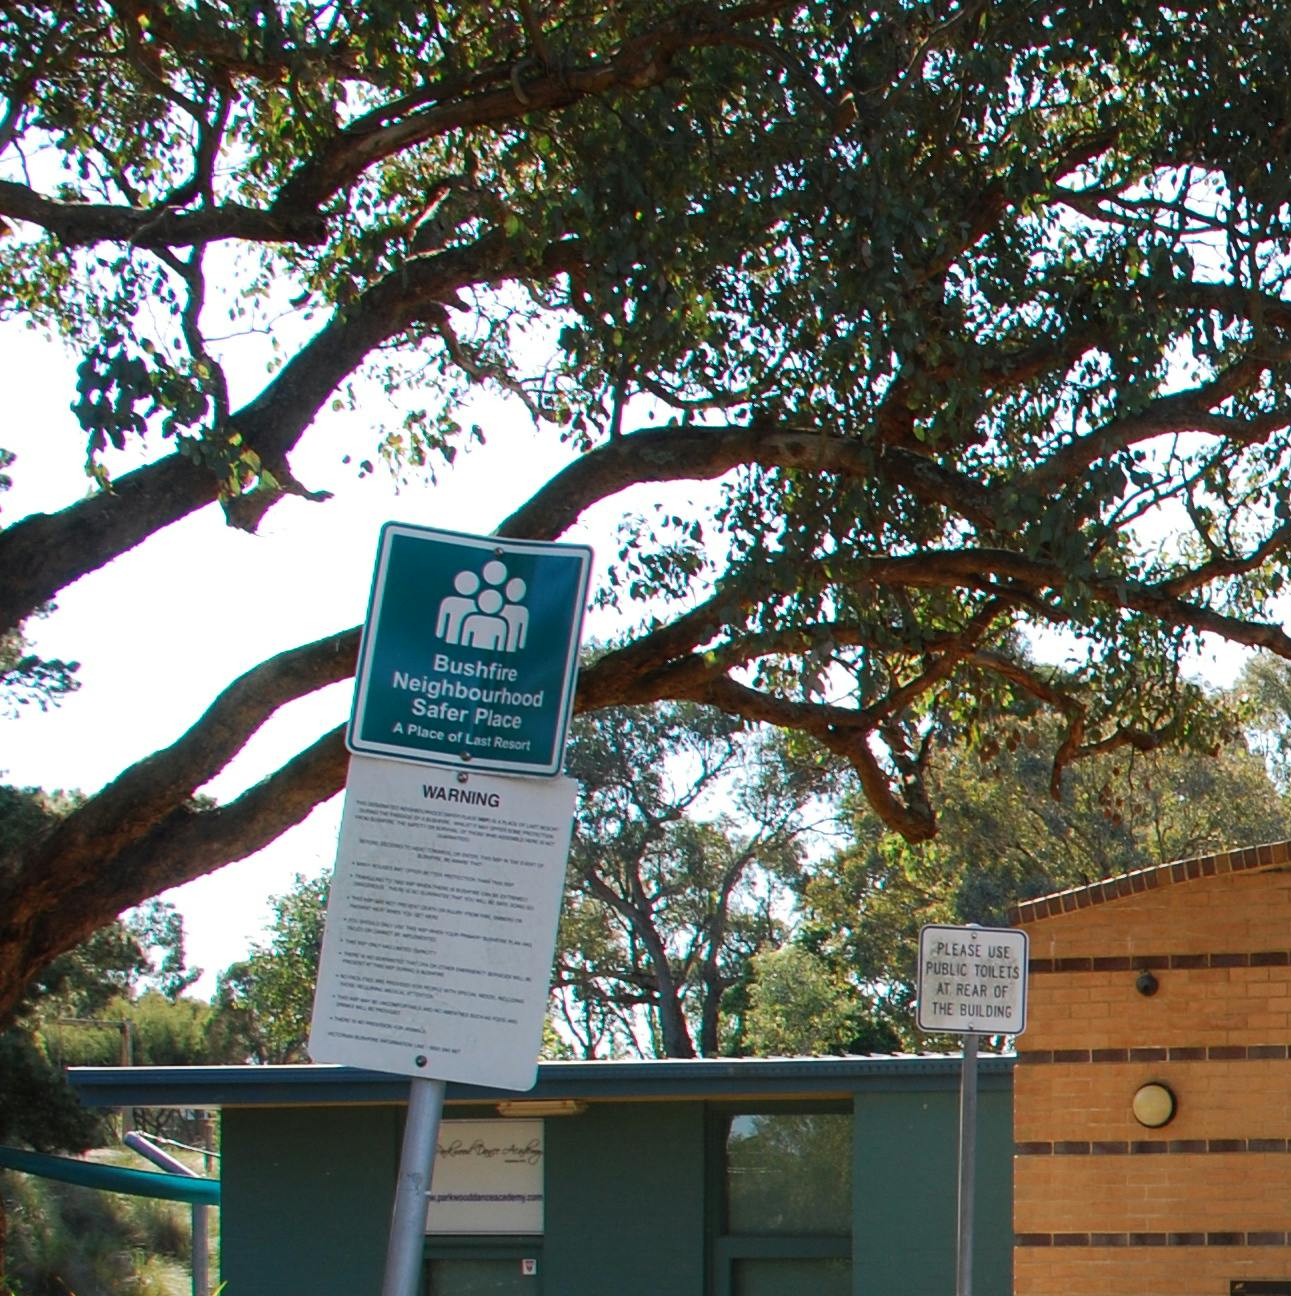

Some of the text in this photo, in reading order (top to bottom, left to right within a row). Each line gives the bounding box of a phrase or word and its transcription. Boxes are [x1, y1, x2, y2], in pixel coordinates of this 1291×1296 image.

[433, 654, 518, 682] Bushfire
[393, 671, 544, 708] Neighbourhood
[412, 698, 522, 730] Safer Place
[392, 722, 531, 751] A Place of Last Resort
[422, 784, 501, 808] WARNING
[936, 942, 1011, 959] PLEASE USE
[925, 961, 1020, 979] PUBLIC TOILETS
[936, 982, 1009, 998] AT REAR OF
[932, 1002, 1012, 1018] THE BUILDING
